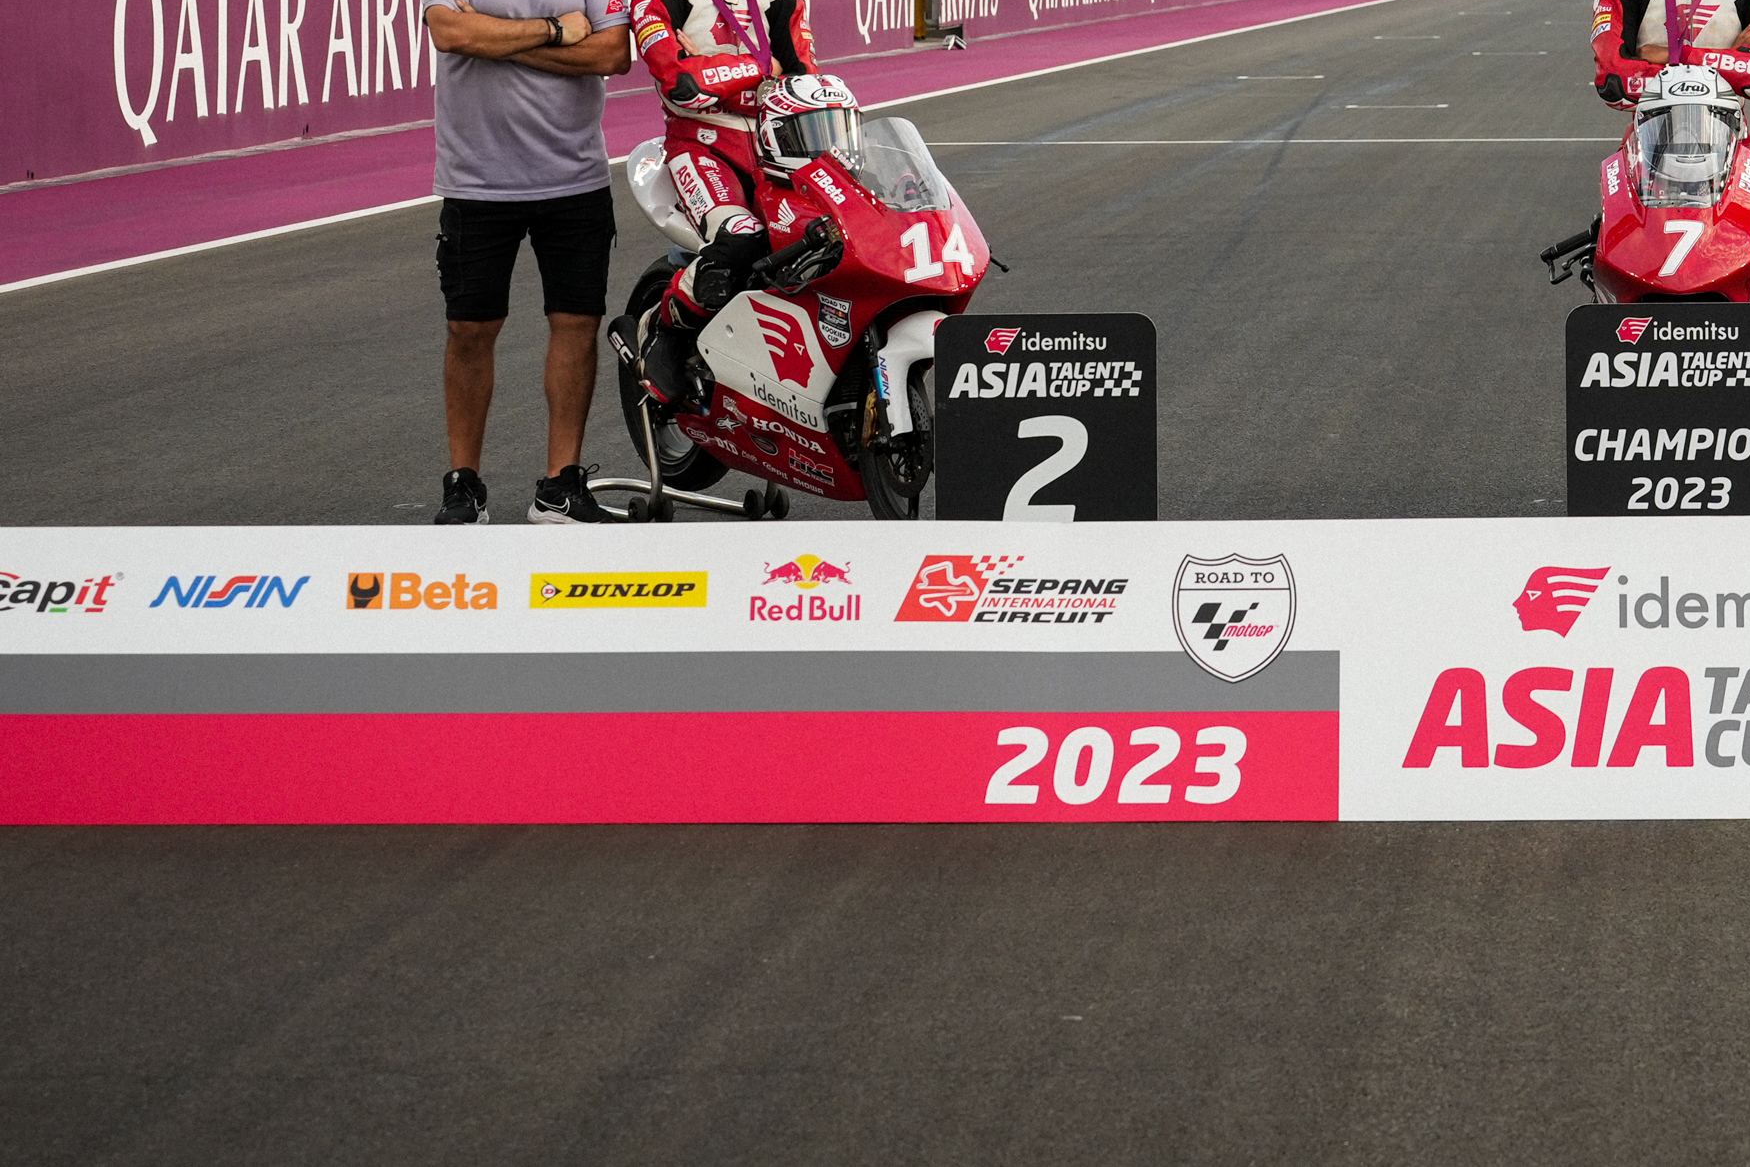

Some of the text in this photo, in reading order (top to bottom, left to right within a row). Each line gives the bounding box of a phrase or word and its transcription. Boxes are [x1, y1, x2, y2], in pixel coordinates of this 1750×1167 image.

[718, 62, 759, 81] Beta
[818, 87, 846, 99] Arai
[1672, 82, 1706, 93] Arai
[676, 165, 698, 198] ASIA
[705, 169, 730, 202] idemitsu
[817, 175, 846, 205] Beta
[1606, 168, 1620, 195] Beta
[769, 221, 791, 234] HONDA
[900, 222, 975, 283] 14
[1658, 219, 1705, 278] 7
[827, 334, 839, 343] CUP
[1021, 331, 1107, 351] idemitsu
[1653, 321, 1739, 341] idemitsu
[949, 362, 1125, 399] ASIA TALENT
[1580, 352, 1679, 388] ASIA
[1681, 369, 1723, 387] CUP
[1049, 380, 1091, 397] CUP
[753, 383, 818, 428] idemitsu
[752, 417, 826, 454] HONDA
[1002, 415, 1089, 522] 2
[1627, 477, 1732, 510] 2023
[390, 572, 498, 610] Beta
[565, 583, 696, 598] DUNLOP
[988, 578, 1130, 595] SEPANG
[1195, 571, 1276, 585] ROAD TO
[750, 594, 861, 621] Red Bull
[981, 597, 1118, 609] INTERNATIONAL
[973, 610, 1114, 624] CIRCUIT
[1401, 665, 1695, 769] ASIA
[984, 725, 1248, 805] 2023
